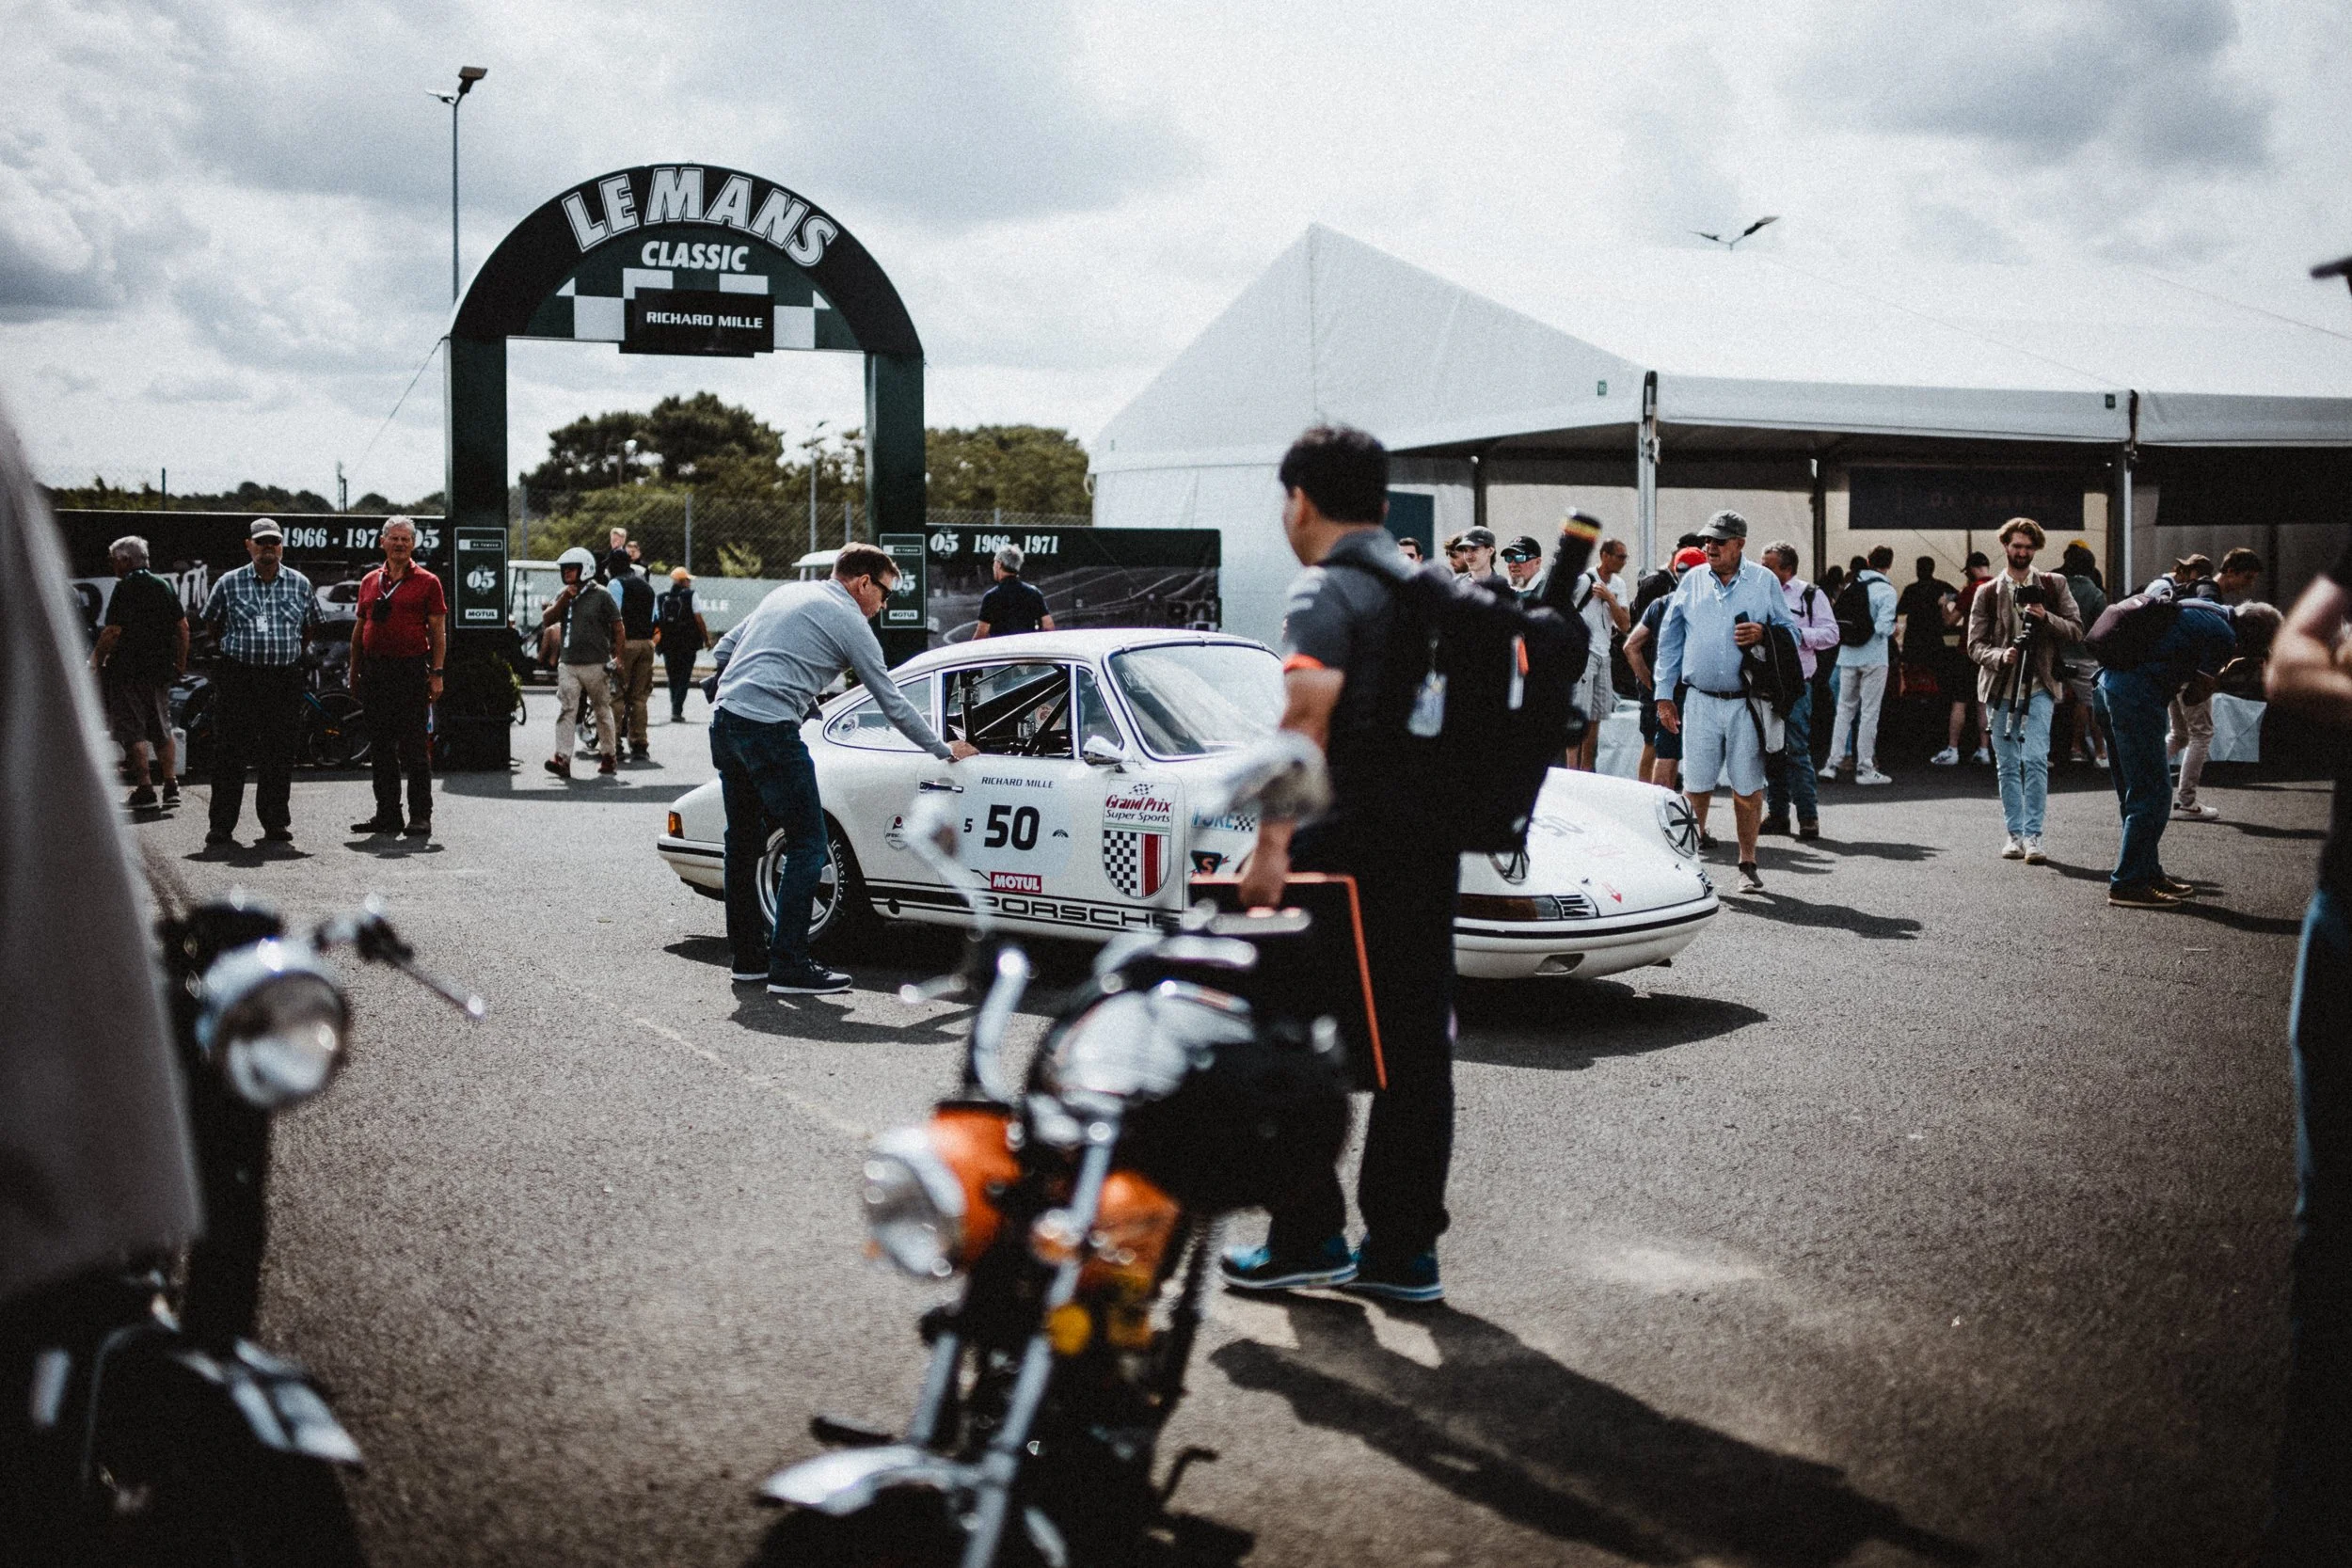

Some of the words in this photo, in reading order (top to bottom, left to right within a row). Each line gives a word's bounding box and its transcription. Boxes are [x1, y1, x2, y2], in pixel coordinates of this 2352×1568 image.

[562, 174, 640, 253] LE
[644, 167, 839, 267] MANS
[641, 240, 750, 272] CLASSIC
[646, 310, 714, 327] RICHARD
[718, 315, 763, 328] MILLE
[281, 528, 327, 548] 1966
[345, 528, 381, 548] 197
[930, 532, 959, 552] 05
[1024, 535, 1058, 554] 1971
[467, 570, 496, 589] 05
[981, 776, 1023, 786] RICHARD
[1025, 779, 1054, 788] MILLE
[1105, 794, 1145, 810] Grand
[1144, 797, 1173, 813] Prix
[963, 818, 974, 833] 5
[1106, 810, 1136, 820] Super
[1137, 812, 1170, 823] Sports
[984, 804, 1041, 850] 50
[993, 875, 1041, 891] MOTUL
